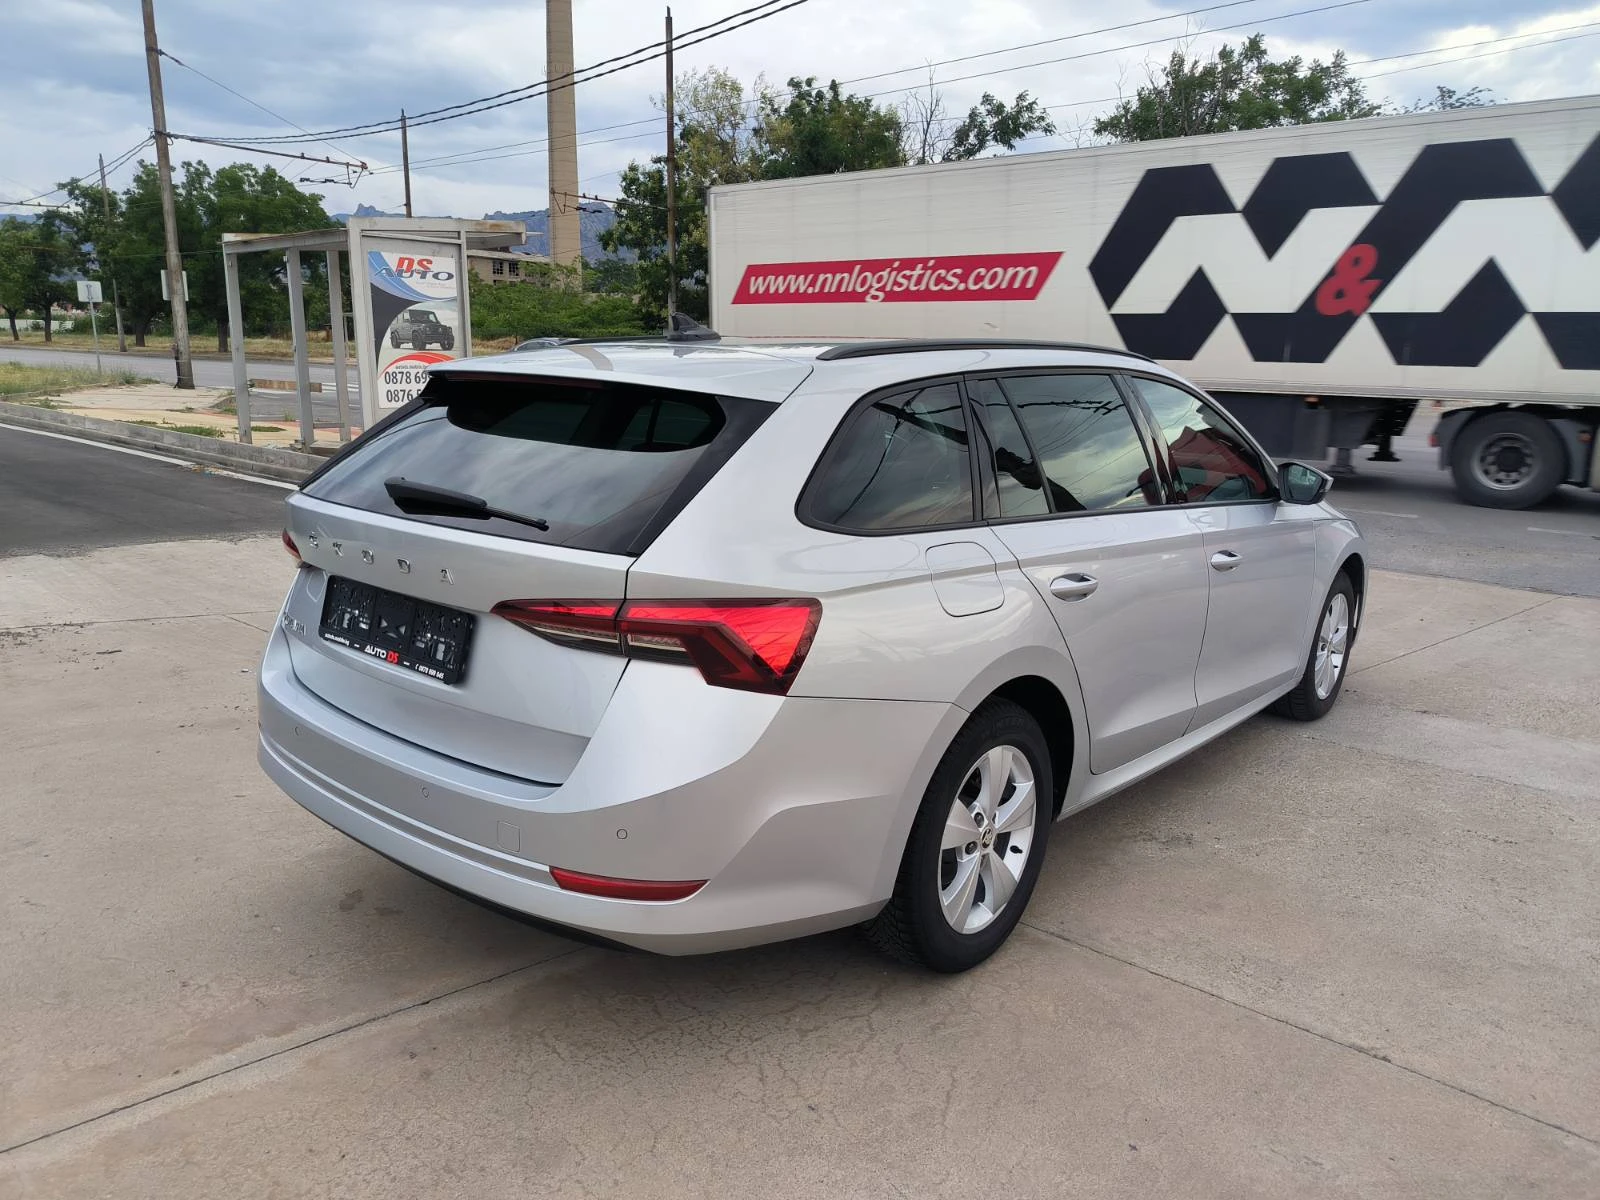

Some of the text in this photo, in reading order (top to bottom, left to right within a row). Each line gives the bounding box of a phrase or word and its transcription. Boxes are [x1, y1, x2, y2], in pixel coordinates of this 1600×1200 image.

[375, 267, 454, 281] AUTO
[749, 260, 1038, 303] www.nnlogistics.com
[384, 370, 430, 385] 0878 69
[386, 389, 414, 403] 0876
[364, 644, 400, 664] AUTO DS
